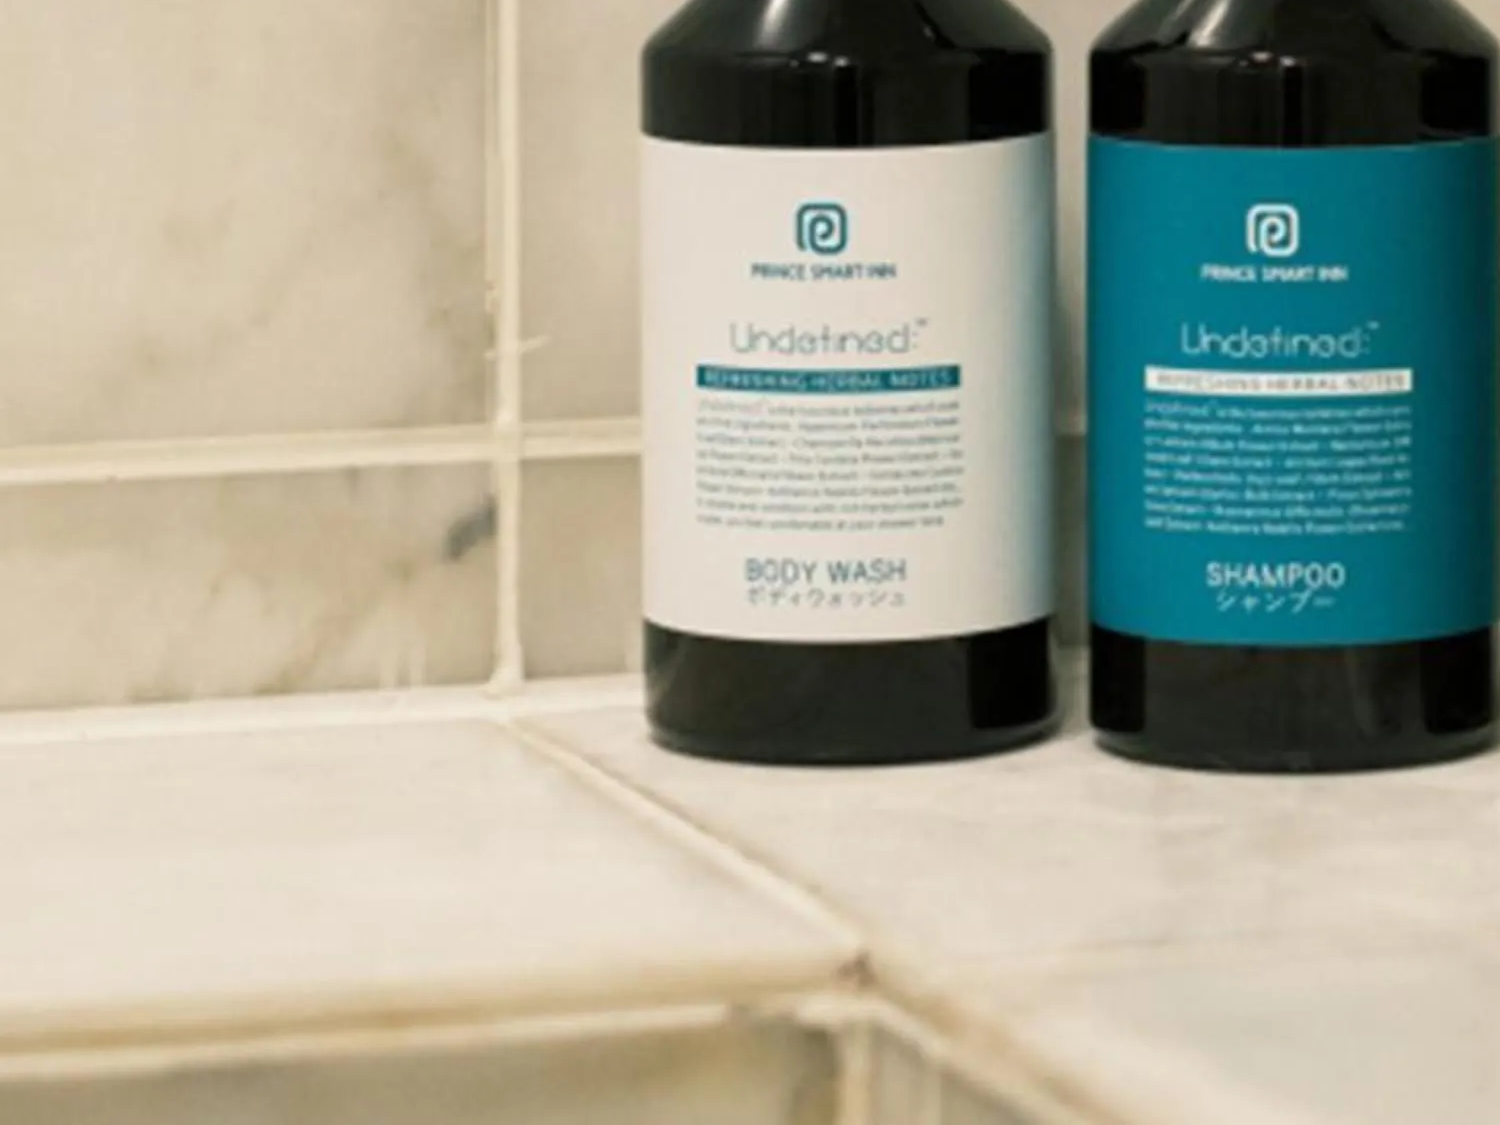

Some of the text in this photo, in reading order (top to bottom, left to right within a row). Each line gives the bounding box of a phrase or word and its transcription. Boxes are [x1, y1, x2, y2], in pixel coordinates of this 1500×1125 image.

[751, 262, 898, 280] PRINCE SMART INN
[1201, 264, 1349, 282] PRINCE SMART INN
[745, 557, 907, 585] BODY WASH
[1205, 561, 1346, 589] SHAMPOO
[1215, 588, 1338, 615] シャンプー
